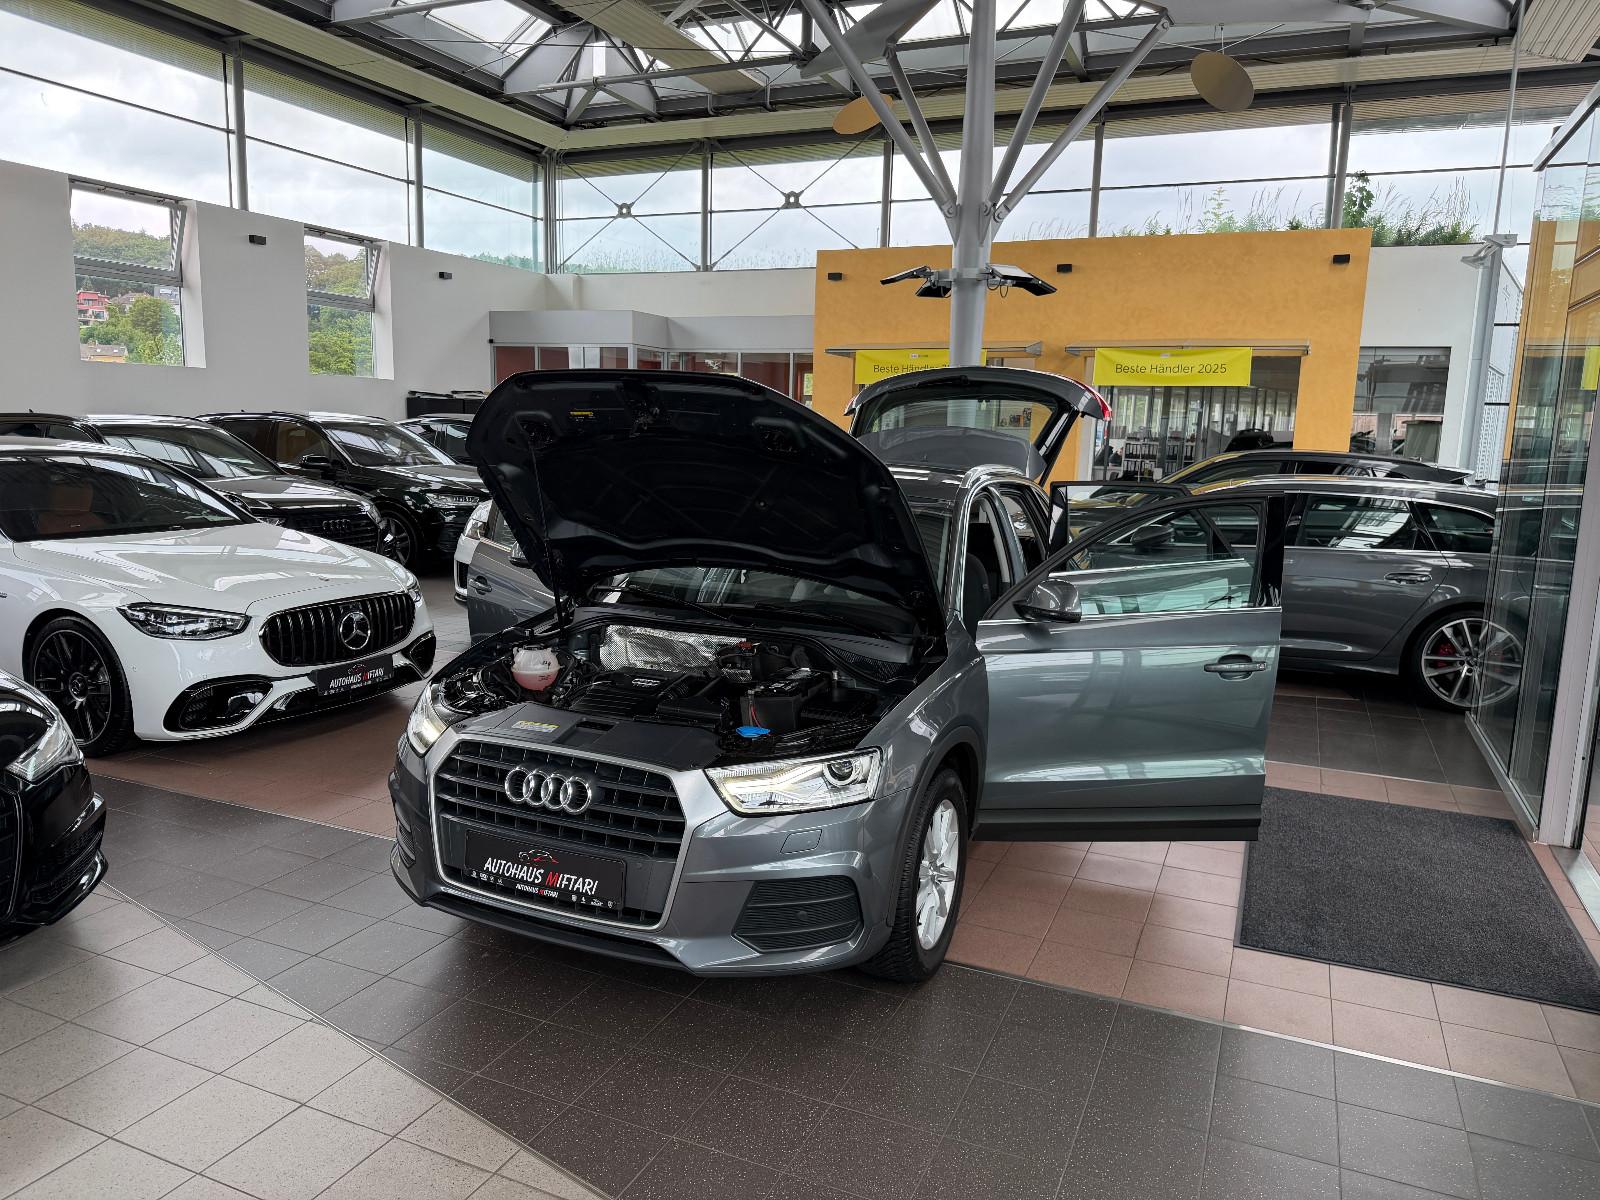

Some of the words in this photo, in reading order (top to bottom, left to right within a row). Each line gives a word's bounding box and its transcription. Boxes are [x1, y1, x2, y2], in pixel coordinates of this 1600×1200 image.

[873, 364, 900, 374] Beste
[902, 364, 938, 373] Händl
[1115, 363, 1147, 374] Beste
[1150, 363, 1194, 374] Händler
[1198, 363, 1227, 374] 2025
[329, 674, 362, 688] AUTOHAUS
[484, 858, 544, 883] AUTOHAUS
[546, 872, 598, 895] MIFTARI
